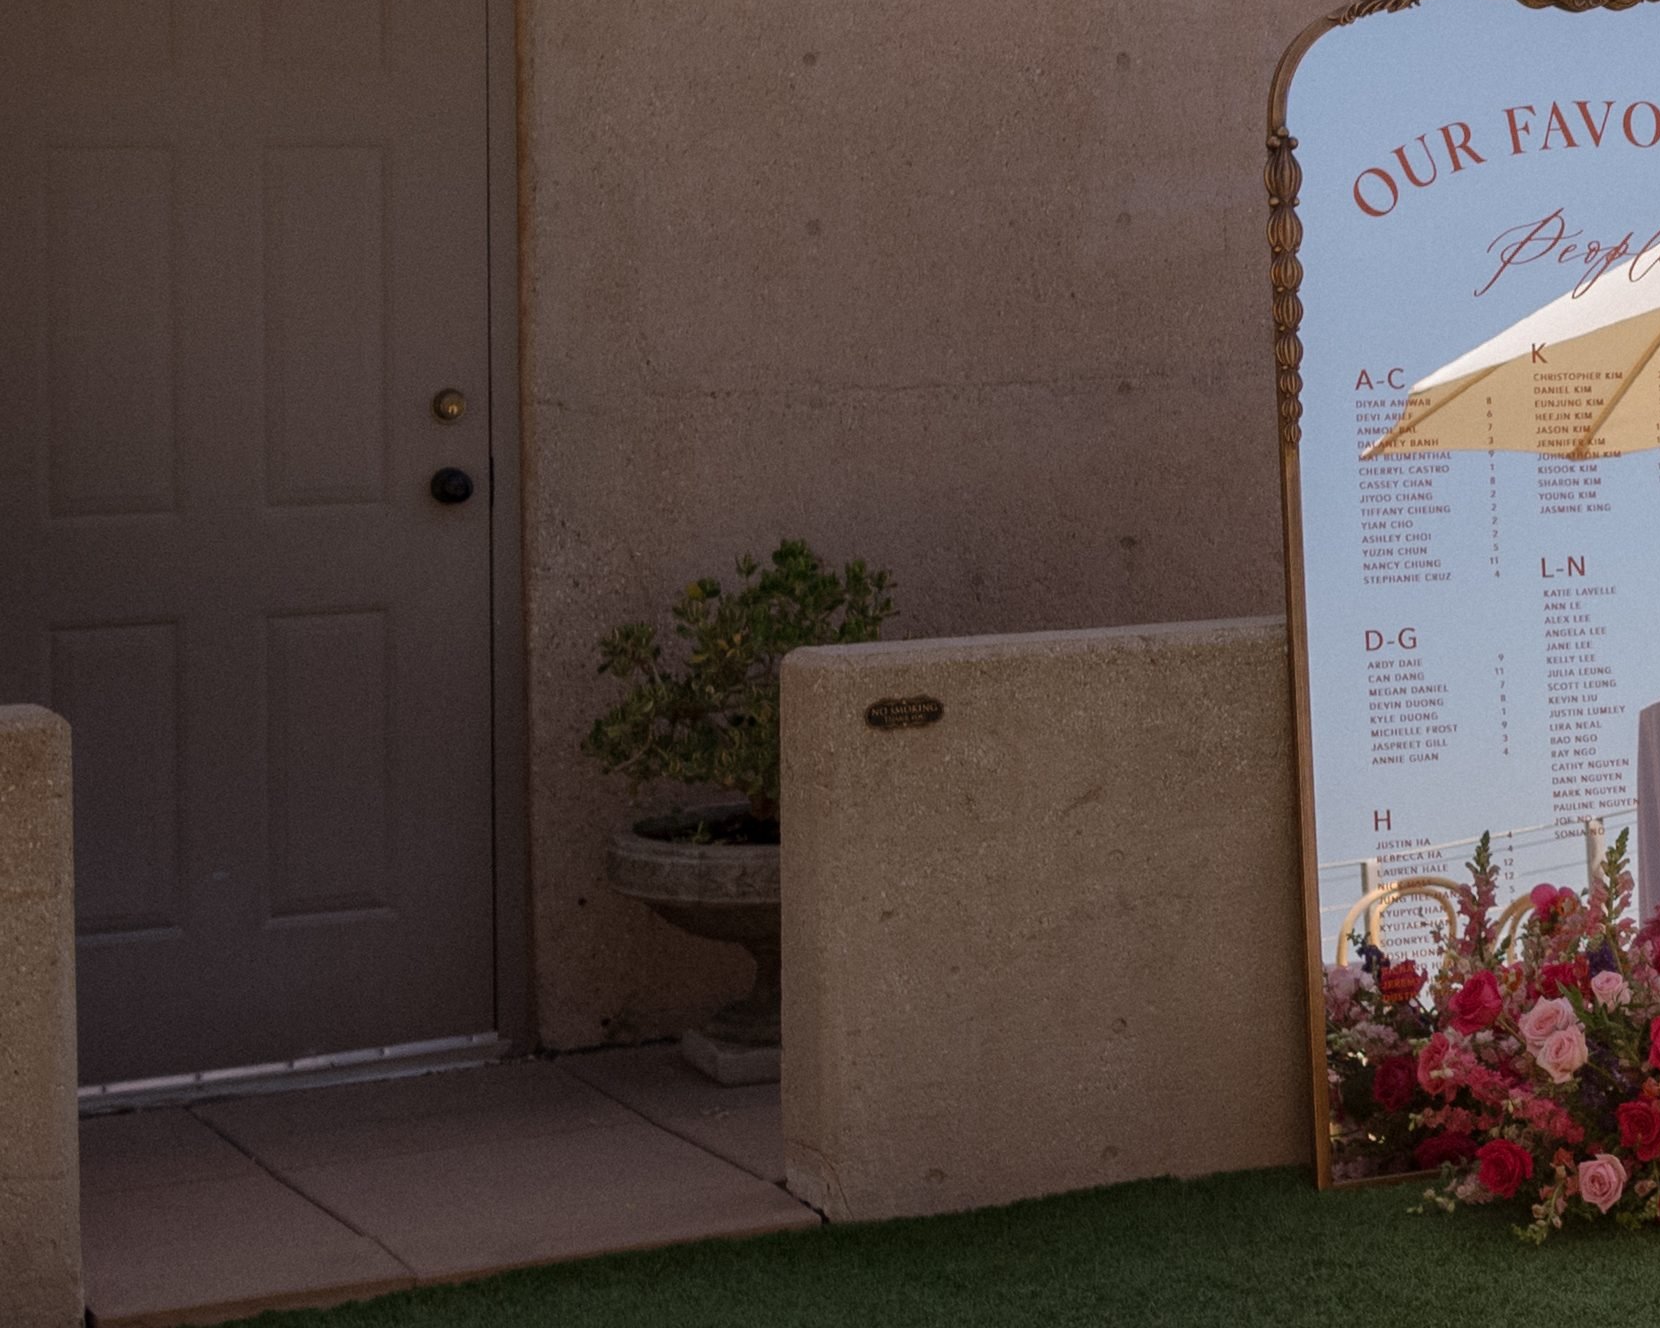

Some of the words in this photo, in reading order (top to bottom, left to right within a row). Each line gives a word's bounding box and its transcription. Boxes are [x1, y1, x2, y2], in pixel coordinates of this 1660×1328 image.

[1353, 121, 1487, 217] OUR
[1532, 343, 1548, 364] K
[1354, 368, 1406, 391] A-C
[1533, 372, 1601, 381] CHRISTOPHER
[1605, 371, 1623, 379] KIM
[1534, 386, 1570, 394] DANIEL
[1574, 385, 1592, 393] KIM
[1356, 400, 1385, 408] DIYAR
[1535, 399, 1582, 408] EUNJUNG
[1586, 398, 1604, 406] KIM
[1356, 413, 1380, 422] DEVI
[1536, 412, 1570, 421] HEEJIN
[1575, 412, 1592, 420] KIM
[1536, 426, 1568, 434] JASON
[1573, 425, 1591, 433] KIM
[1410, 438, 1439, 447] BANH
[1537, 439, 1584, 448] JENNIFER
[1384, 452, 1452, 461] BLUMENTHAL
[1359, 467, 1403, 476] CHERRYL
[1409, 465, 1449, 474] CASTRO
[1491, 463, 1494, 471] 1
[1538, 465, 1575, 474] KISOOK
[1359, 481, 1398, 489] CASSEY
[1403, 479, 1432, 488] CHAN
[1538, 478, 1579, 487] SHARON
[1584, 477, 1601, 486] KIM
[1360, 494, 1391, 503] JIYOO
[1396, 492, 1432, 501] CHANG
[1490, 490, 1496, 498] 2
[1538, 492, 1574, 501] YOUNG
[1579, 491, 1596, 499] KIM
[1360, 507, 1403, 517] TIFFANY
[1408, 505, 1451, 515] CHEUNG
[1491, 503, 1497, 511] 2
[1540, 505, 1583, 514] JASMINE
[1587, 503, 1611, 512] KING
[1361, 521, 1386, 530] YIAN
[1391, 520, 1413, 528] CHO
[1491, 517, 1498, 525] 2
[1362, 534, 1401, 544] ASHLEY
[1405, 533, 1431, 542] CHOI
[1492, 530, 1498, 538] 2
[1362, 548, 1393, 557] YUZIN
[1398, 547, 1427, 555] CHUN
[1493, 543, 1499, 551] 5
[1363, 561, 1400, 571] NANCY
[1404, 559, 1441, 568] CHUNG
[1490, 557, 1498, 565] 11
[1541, 555, 1585, 578] L-N
[1363, 574, 1420, 584] STEPHANIE
[1425, 572, 1452, 581] CRUZ
[1494, 570, 1500, 578] 4
[1544, 589, 1571, 597] KATIE
[1576, 585, 1616, 596] LAVELLE
[1544, 603, 1566, 611] ANN
[1570, 601, 1581, 609] LE
[1545, 616, 1570, 624] ALEX
[1573, 614, 1591, 622] LEE
[1545, 628, 1586, 638] ANGELA
[1590, 626, 1606, 635] LEE
[1364, 627, 1417, 651] D-G
[1546, 642, 1571, 651] JANE
[1575, 640, 1592, 648] LEE
[1368, 660, 1394, 670] ARDY
[1547, 656, 1574, 664] KELLY
[1579, 654, 1595, 662] LEE
[1368, 674, 1390, 683] CAN
[1395, 672, 1424, 681] DANG
[1494, 667, 1504, 675] 11
[1547, 670, 1575, 678] JULIA
[1579, 667, 1611, 676] LEUNG
[1369, 687, 1406, 697] MEGAN
[1411, 684, 1448, 694] DANIEL
[1501, 680, 1505, 688] 7
[1548, 682, 1579, 691] SCOTT
[1584, 679, 1616, 688] LEUNG
[1369, 701, 1401, 711] DEVIN
[1406, 698, 1444, 708] DUONG
[1548, 695, 1578, 704] KEVIN
[1583, 694, 1597, 702] LIU
[891, 702, 938, 715] SMOKING
[1549, 709, 1583, 718] JUSTIN
[1588, 705, 1625, 715] LUMLEY
[1370, 715, 1395, 724] KYLE
[1400, 712, 1438, 722] DUONG
[1371, 728, 1421, 737] MICHELLE
[1426, 724, 1458, 734] FROST
[1550, 723, 1571, 732] LIRA
[1576, 720, 1601, 729] NEAL
[1371, 741, 1421, 751] JASPREET
[1426, 739, 1447, 747] GILL
[1502, 734, 1508, 742] 3
[1550, 736, 1571, 745] BAO
[1574, 734, 1597, 743] NGO
[1372, 755, 1404, 765] ANNIE
[1409, 753, 1438, 762] GUAN
[1503, 748, 1508, 756] 4
[1573, 747, 1596, 756] NGO
[1552, 762, 1583, 772] CATHY
[1588, 758, 1629, 769] NGUYEN
[1552, 776, 1576, 785] DANI
[1581, 773, 1622, 782] NGUYEN
[1553, 790, 1580, 798] MARK
[1585, 786, 1626, 795] NGUYEN
[1554, 802, 1595, 812] PAULINE
[1599, 798, 1639, 808] NGUYEN
[1374, 809, 1391, 831] H
[1376, 839, 1412, 850] JUSTIN
[1416, 838, 1431, 846] HA
[1377, 853, 1424, 863] REBECCA
[1428, 850, 1442, 859] HA
[1377, 866, 1417, 877] LAUREN
[1422, 863, 1448, 873] HALE
[1504, 858, 1513, 866] 12
